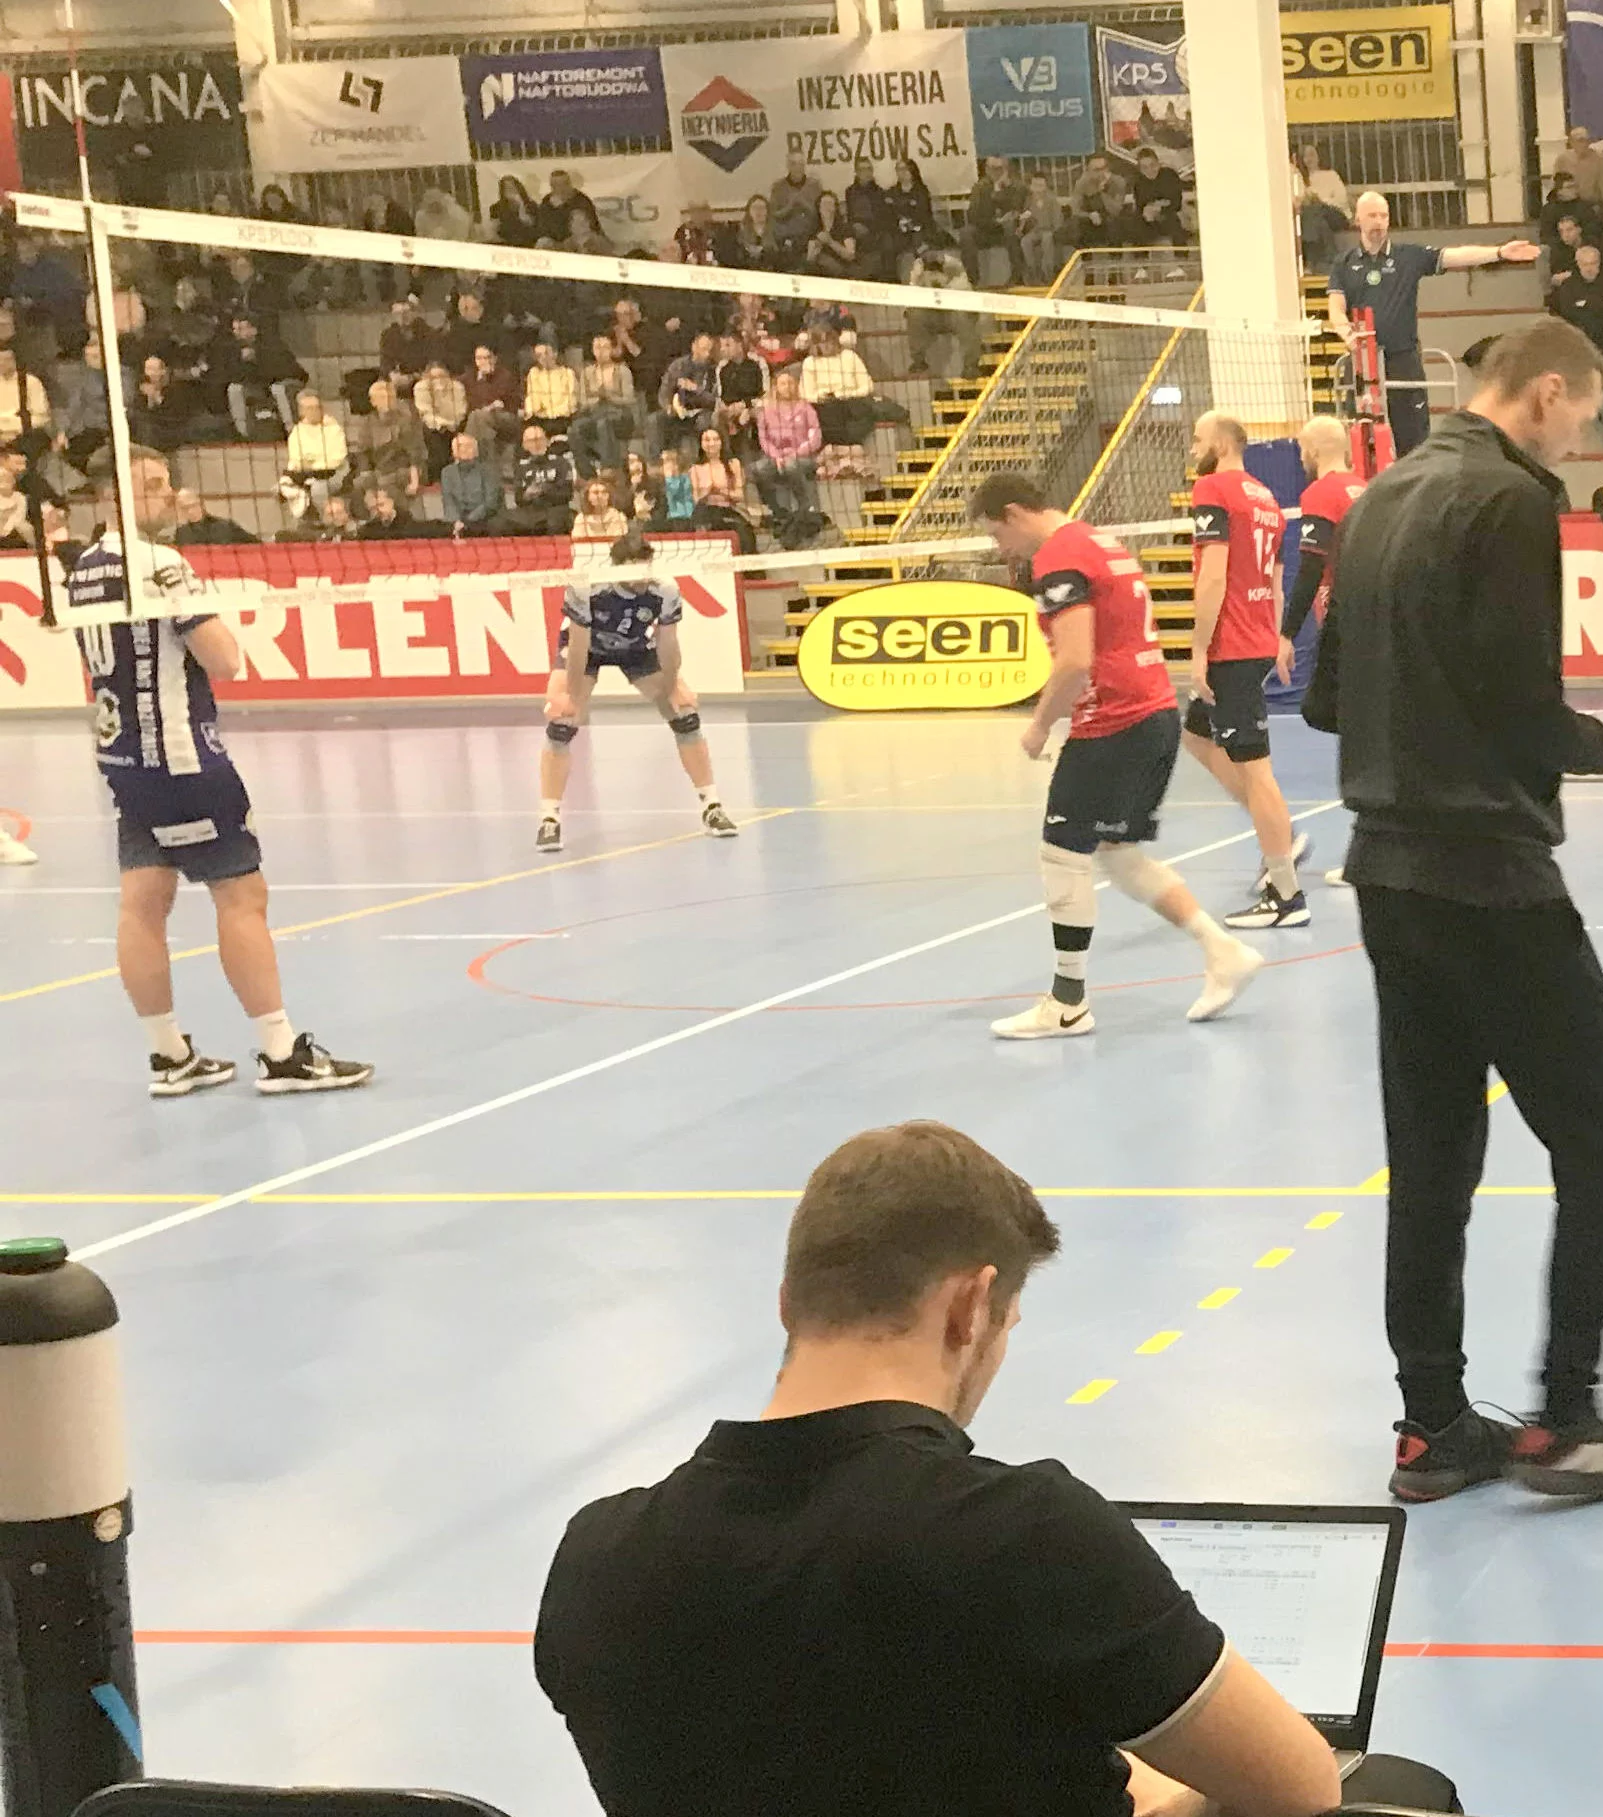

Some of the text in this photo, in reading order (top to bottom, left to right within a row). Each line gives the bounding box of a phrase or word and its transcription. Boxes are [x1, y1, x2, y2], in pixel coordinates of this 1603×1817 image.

[1281, 33, 1426, 74] seen
[517, 66, 646, 84] NAFTOREMONT
[1113, 62, 1168, 86] KPS
[20, 71, 231, 129] INCANA
[517, 82, 649, 99] NAFTOBUDOWA
[1284, 79, 1435, 101] chnologie
[980, 97, 1084, 120] VIRIBUS
[786, 119, 967, 166] RZESZÓW S.A.
[202, 574, 552, 681] RLEN
[836, 617, 1020, 659] seen
[830, 667, 1027, 689] technologie
